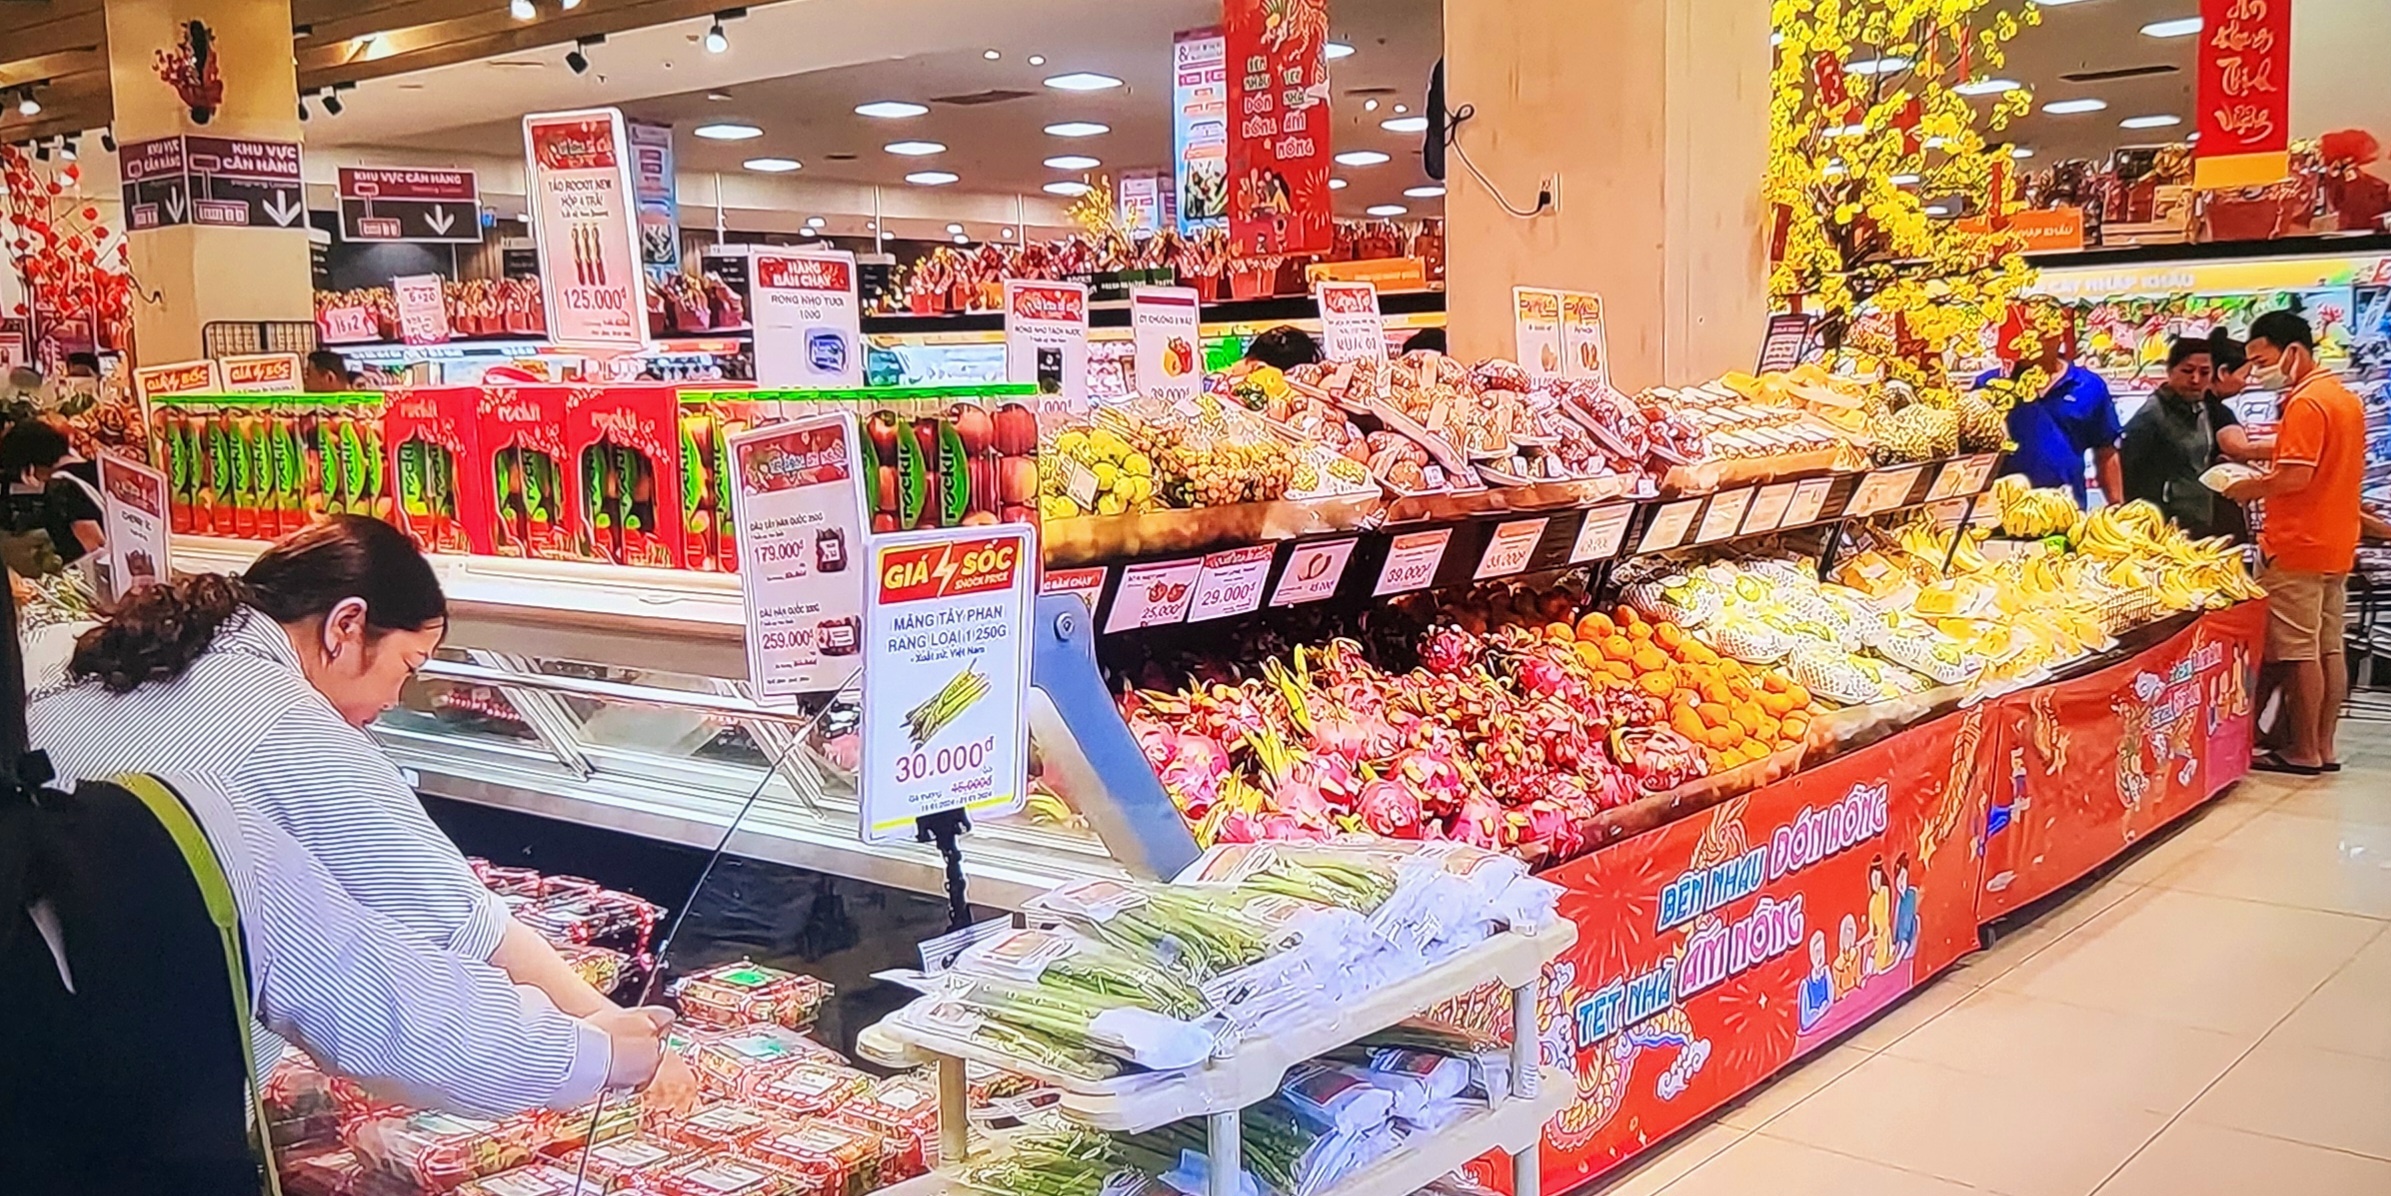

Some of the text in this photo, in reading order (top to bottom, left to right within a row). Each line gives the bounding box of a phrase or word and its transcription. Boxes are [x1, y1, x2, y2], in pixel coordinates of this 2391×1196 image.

[2216, 56, 2278, 97] Thịnh
[2213, 101, 2273, 144] Vượng
[231, 142, 297, 160] KHU VỰC
[222, 156, 298, 175] CÂN HÀNG
[354, 171, 462, 185] KHU VỰC CÂN HÀNG
[563, 286, 627, 311] 125.000đ
[900, 443, 914, 519] rockit
[942, 444, 957, 519] rockit
[754, 538, 805, 566] 179.000đ
[884, 539, 1014, 590] GIÁ SỐC
[1201, 581, 1257, 607] 29.000đ
[894, 605, 1003, 631] MĂNG TÂY PHAN
[762, 629, 814, 650] 259.000đ
[888, 635, 927, 652] RANG
[931, 629, 962, 648] LOẠI
[976, 624, 1007, 640] 250G
[895, 735, 994, 783] 30.000đ
[1657, 871, 1707, 932] BÊN
[1706, 845, 1767, 911] NHAU
[1769, 805, 1828, 881] ĐÓN
[1576, 894, 1804, 1047] TẾT NHÀ ẤM NỒNG
